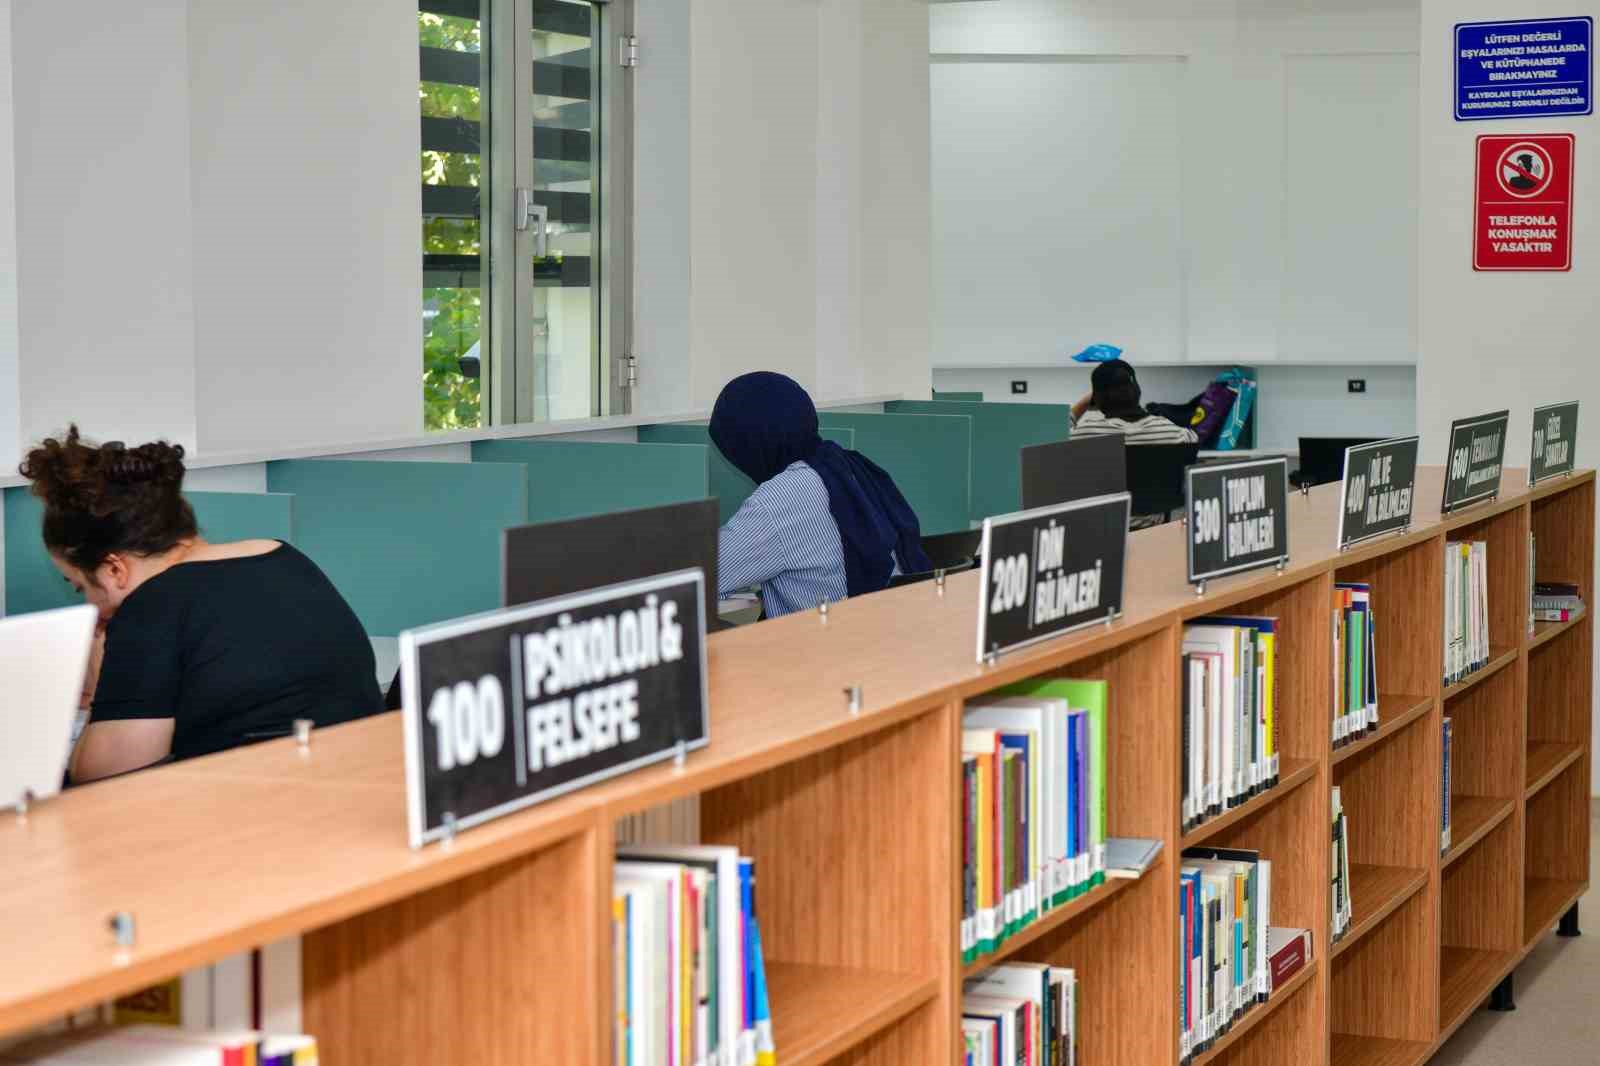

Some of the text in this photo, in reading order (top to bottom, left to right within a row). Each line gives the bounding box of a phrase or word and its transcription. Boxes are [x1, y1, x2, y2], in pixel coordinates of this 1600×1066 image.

[1461, 44, 1586, 59] EŞYALARINIZI MASALARDA
[1485, 30, 1561, 44] LÜTFEN DEĞERLİ
[1481, 57, 1566, 69] VE KÜTÜPHANEDE
[1489, 70, 1558, 81] BIRAKMAYINIZ
[1468, 91, 1510, 99] KAYBOLAN
[1488, 215, 1557, 226] TELEFONLA
[1488, 229, 1557, 241] KONUŞMAK
[1492, 242, 1552, 252] YASAKTIR
[1452, 446, 1469, 480] 600
[1227, 475, 1265, 514] TOPLUM
[1347, 473, 1365, 514] 400
[1378, 481, 1413, 521] BİLİMLERİ
[1194, 498, 1220, 544] 300
[1228, 510, 1274, 557] BİLİMLERİ
[1038, 519, 1065, 572] DİN
[991, 553, 1028, 613] 200
[1035, 560, 1102, 624] BİLİMLERİ
[523, 594, 683, 699] PSİKOLOJİ &
[427, 674, 504, 770] 100
[527, 679, 640, 772] FELSEFE
